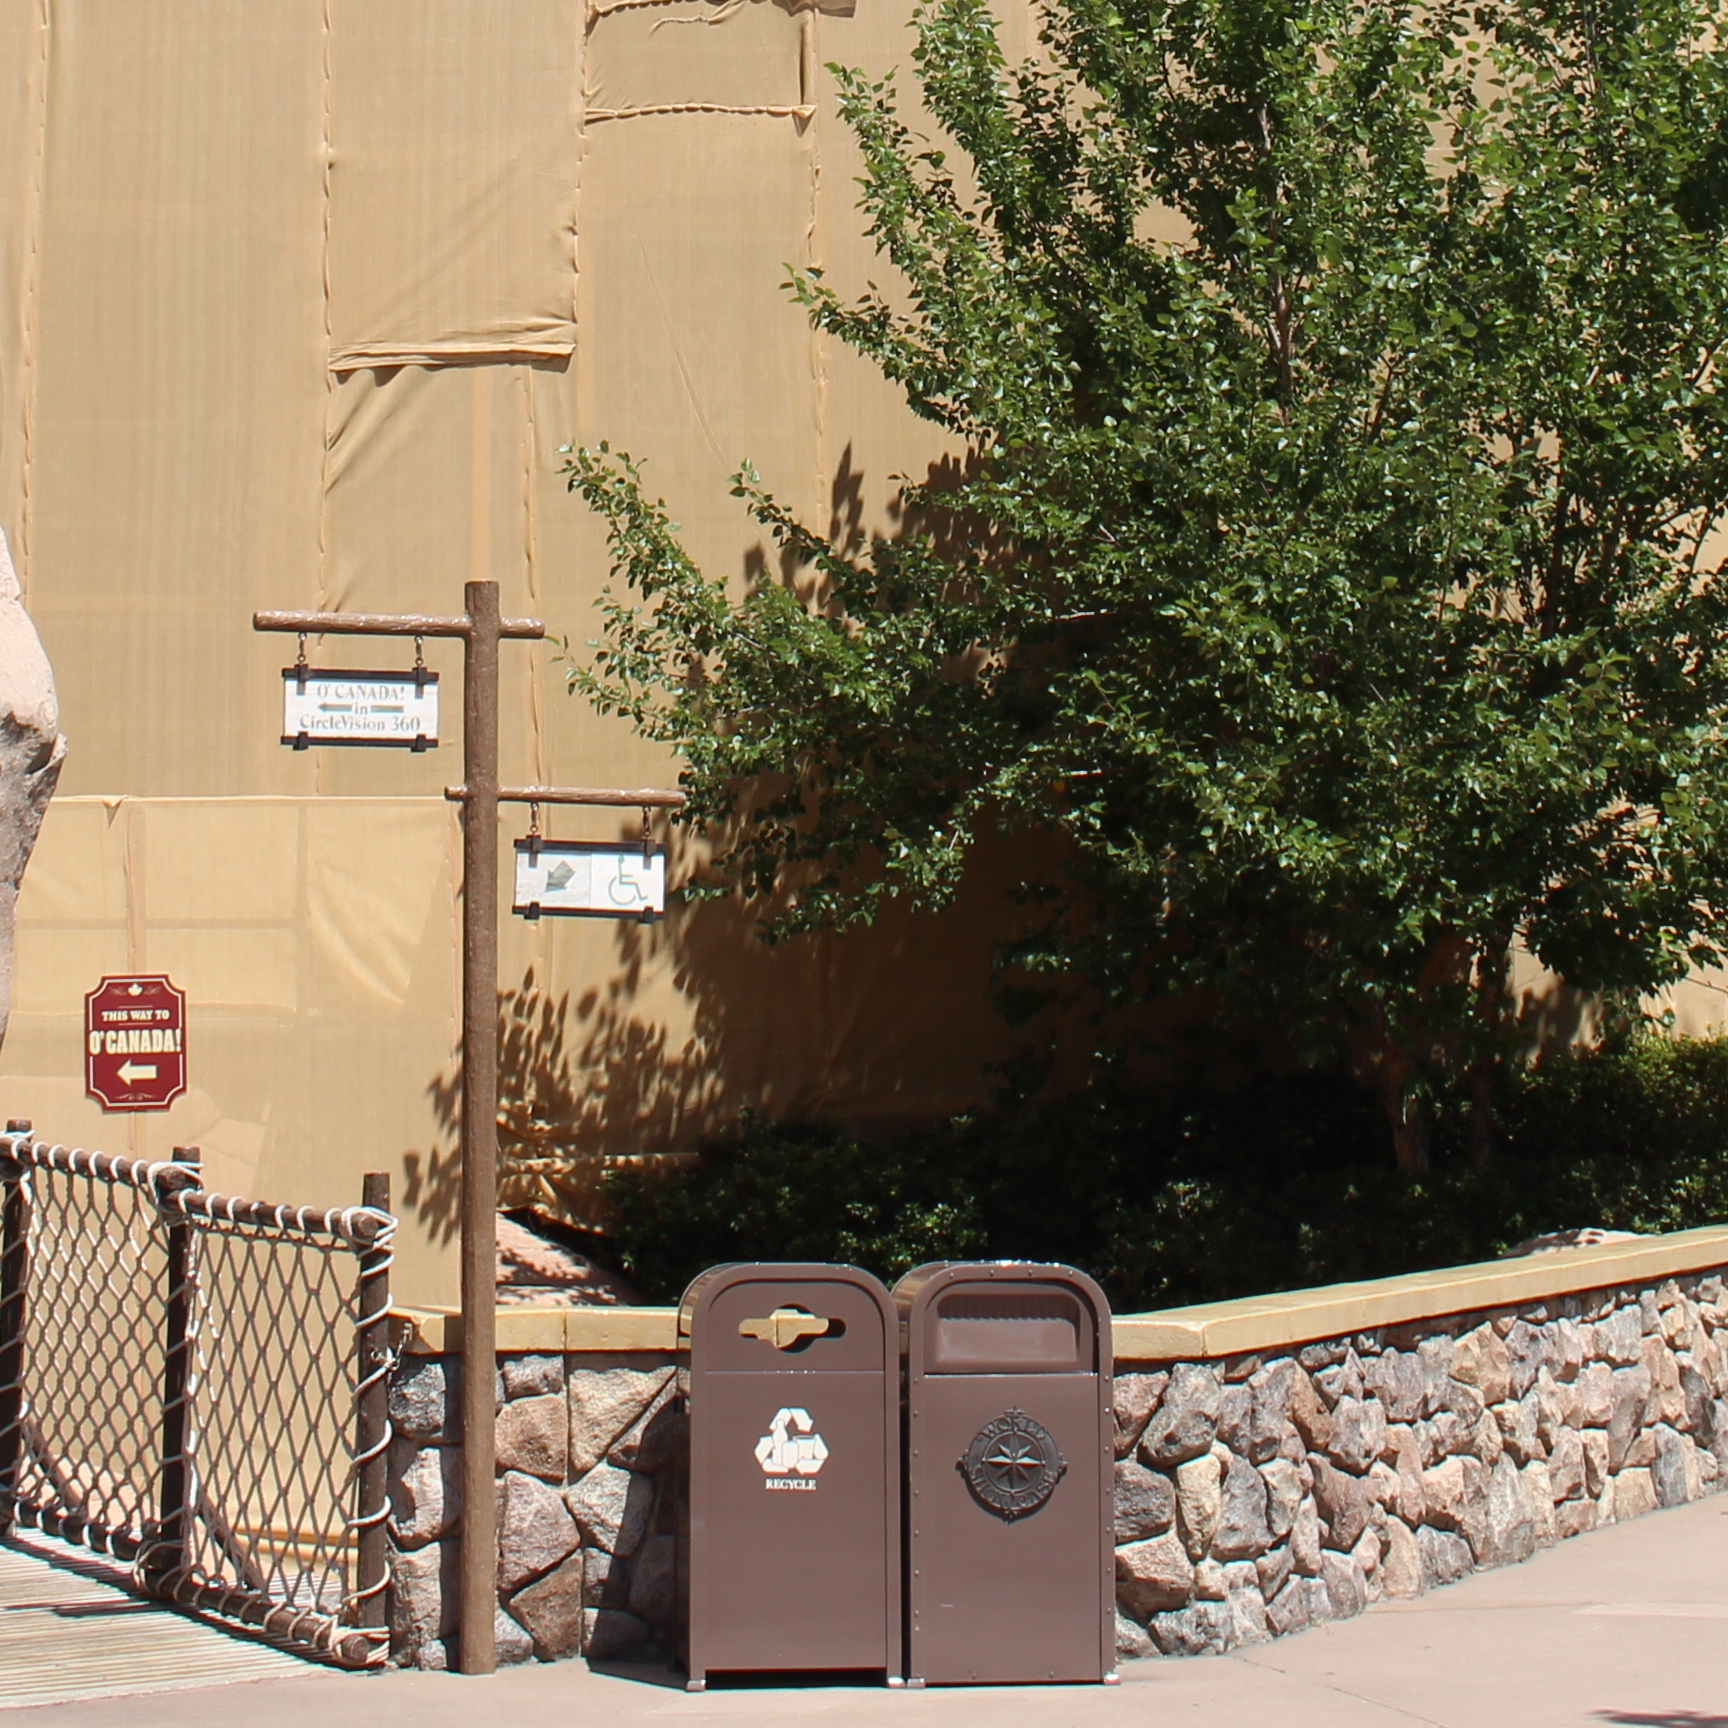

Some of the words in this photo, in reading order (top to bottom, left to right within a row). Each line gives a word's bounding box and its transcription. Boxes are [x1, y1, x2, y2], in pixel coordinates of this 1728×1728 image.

[335, 684, 405, 701] CANADA!
[354, 702, 368, 715] in
[300, 714, 385, 731] CircleVision
[392, 716, 421, 732] 360
[101, 1010, 128, 1021] THIS
[130, 1010, 152, 1021] WAY
[154, 1009, 170, 1020] TO
[976, 1416, 1047, 1442] WORLD
[765, 1478, 817, 1490] RECYCLE
